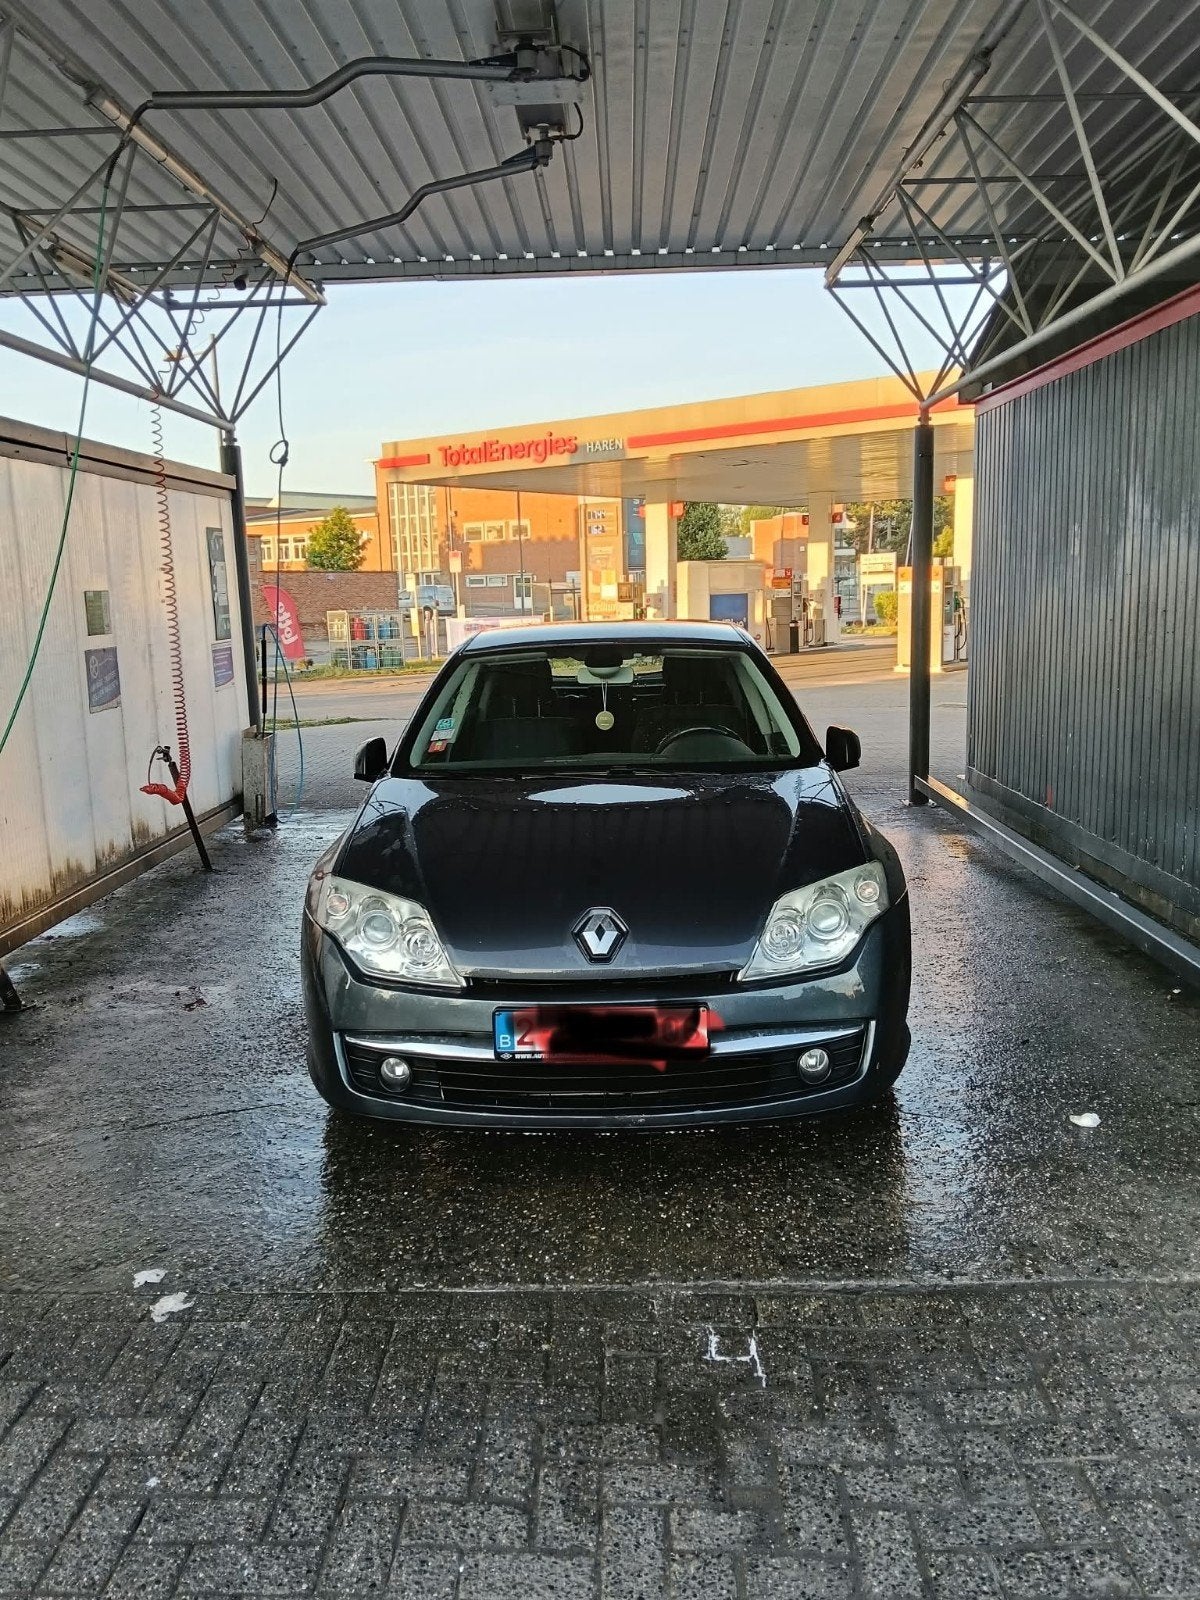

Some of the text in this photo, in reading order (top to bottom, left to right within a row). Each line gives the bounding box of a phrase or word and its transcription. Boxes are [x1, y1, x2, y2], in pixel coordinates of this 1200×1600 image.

[439, 432, 623, 467] TotalEnergies HAREN
[500, 1034, 511, 1047] B
